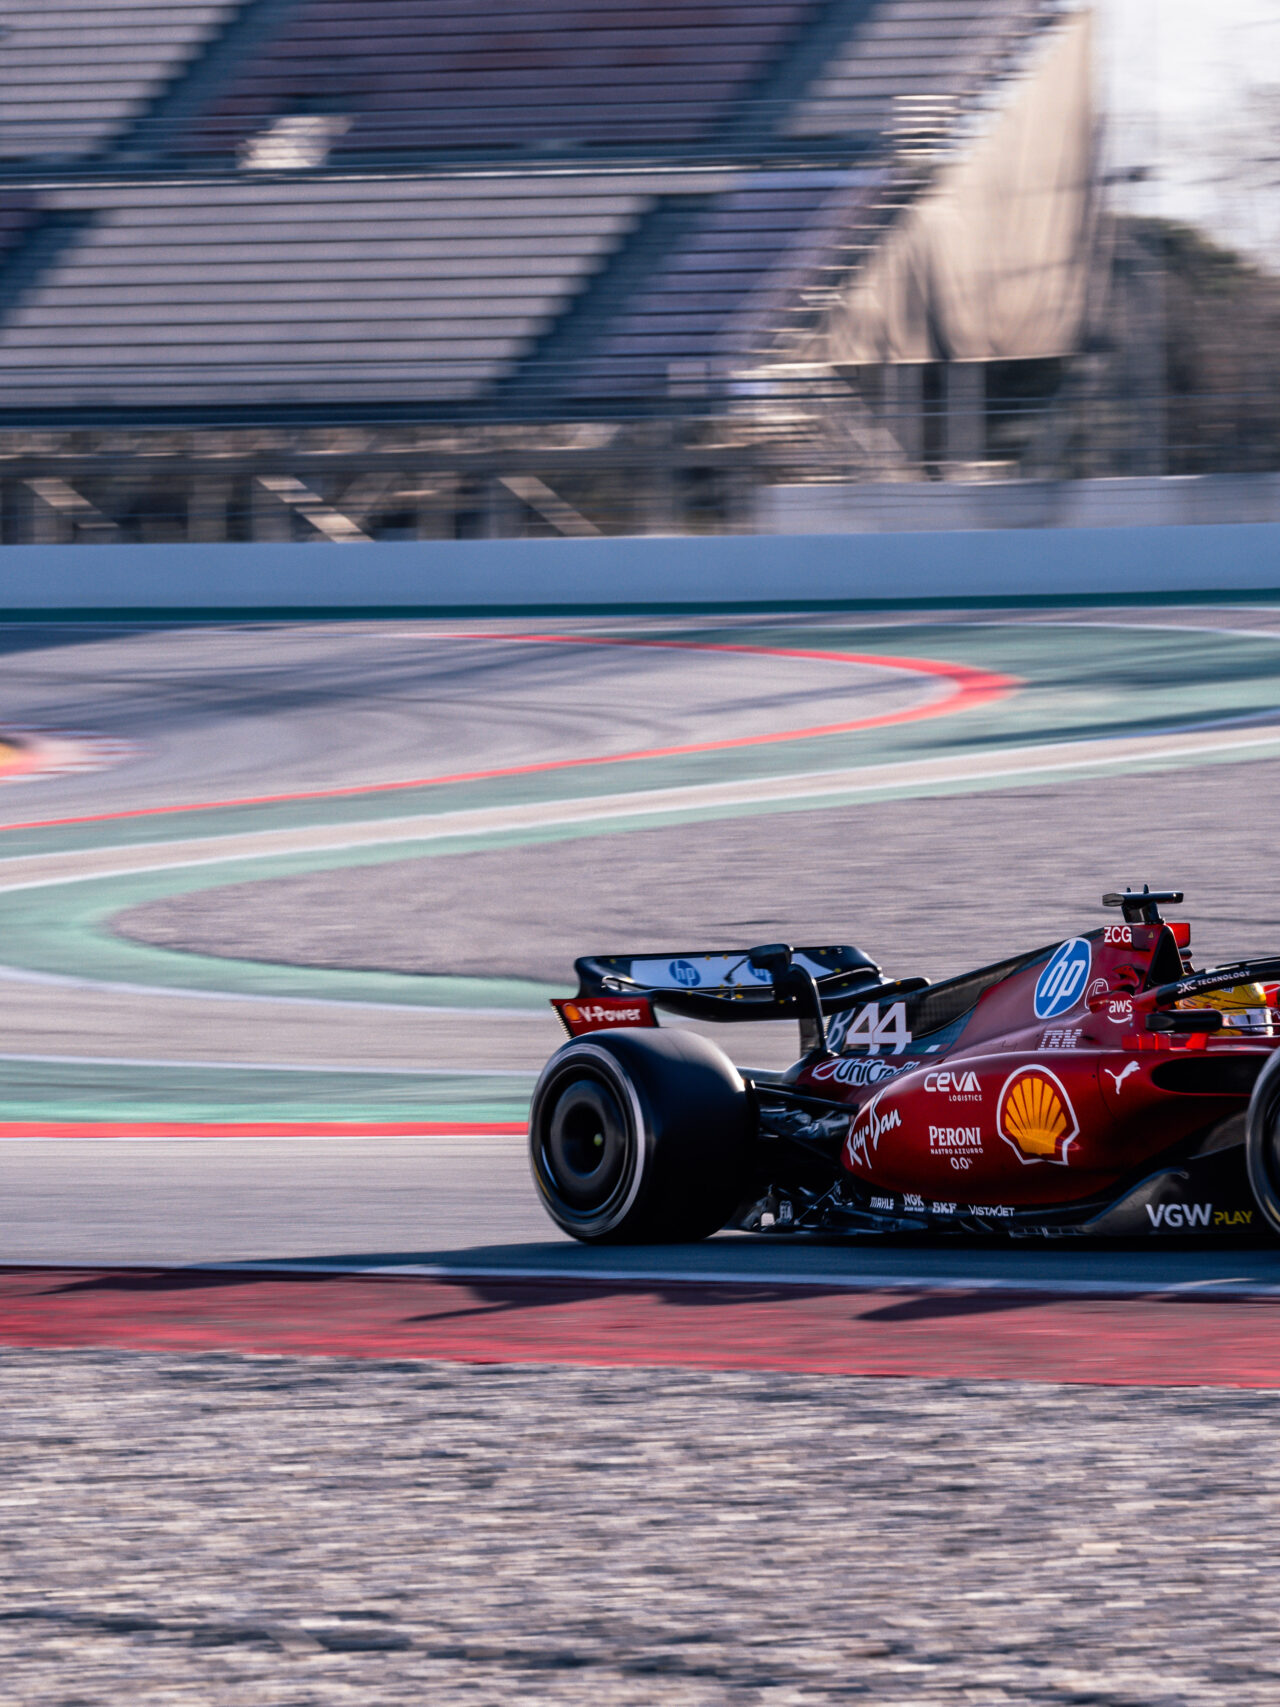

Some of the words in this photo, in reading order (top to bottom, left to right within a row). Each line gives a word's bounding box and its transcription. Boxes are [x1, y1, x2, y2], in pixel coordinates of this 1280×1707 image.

[1103, 926, 1132, 943] ZCG
[673, 960, 698, 986] hp
[1039, 938, 1088, 1018] hp
[1198, 970, 1251, 986] TECHNOLOGY
[579, 1005, 641, 1023] V-Power
[1109, 999, 1133, 1014] aws
[846, 1002, 912, 1055] 44
[1038, 1029, 1082, 1051] IBM
[949, 1094, 983, 1102] LOGISTICS
[928, 1125, 982, 1147] PERONI
[869, 1196, 895, 1210] MAHLE
[903, 1193, 925, 1206] NGK
[932, 1201, 957, 1214] SKF
[1146, 1203, 1213, 1228] VGW
[1213, 1210, 1253, 1225] PLAY
